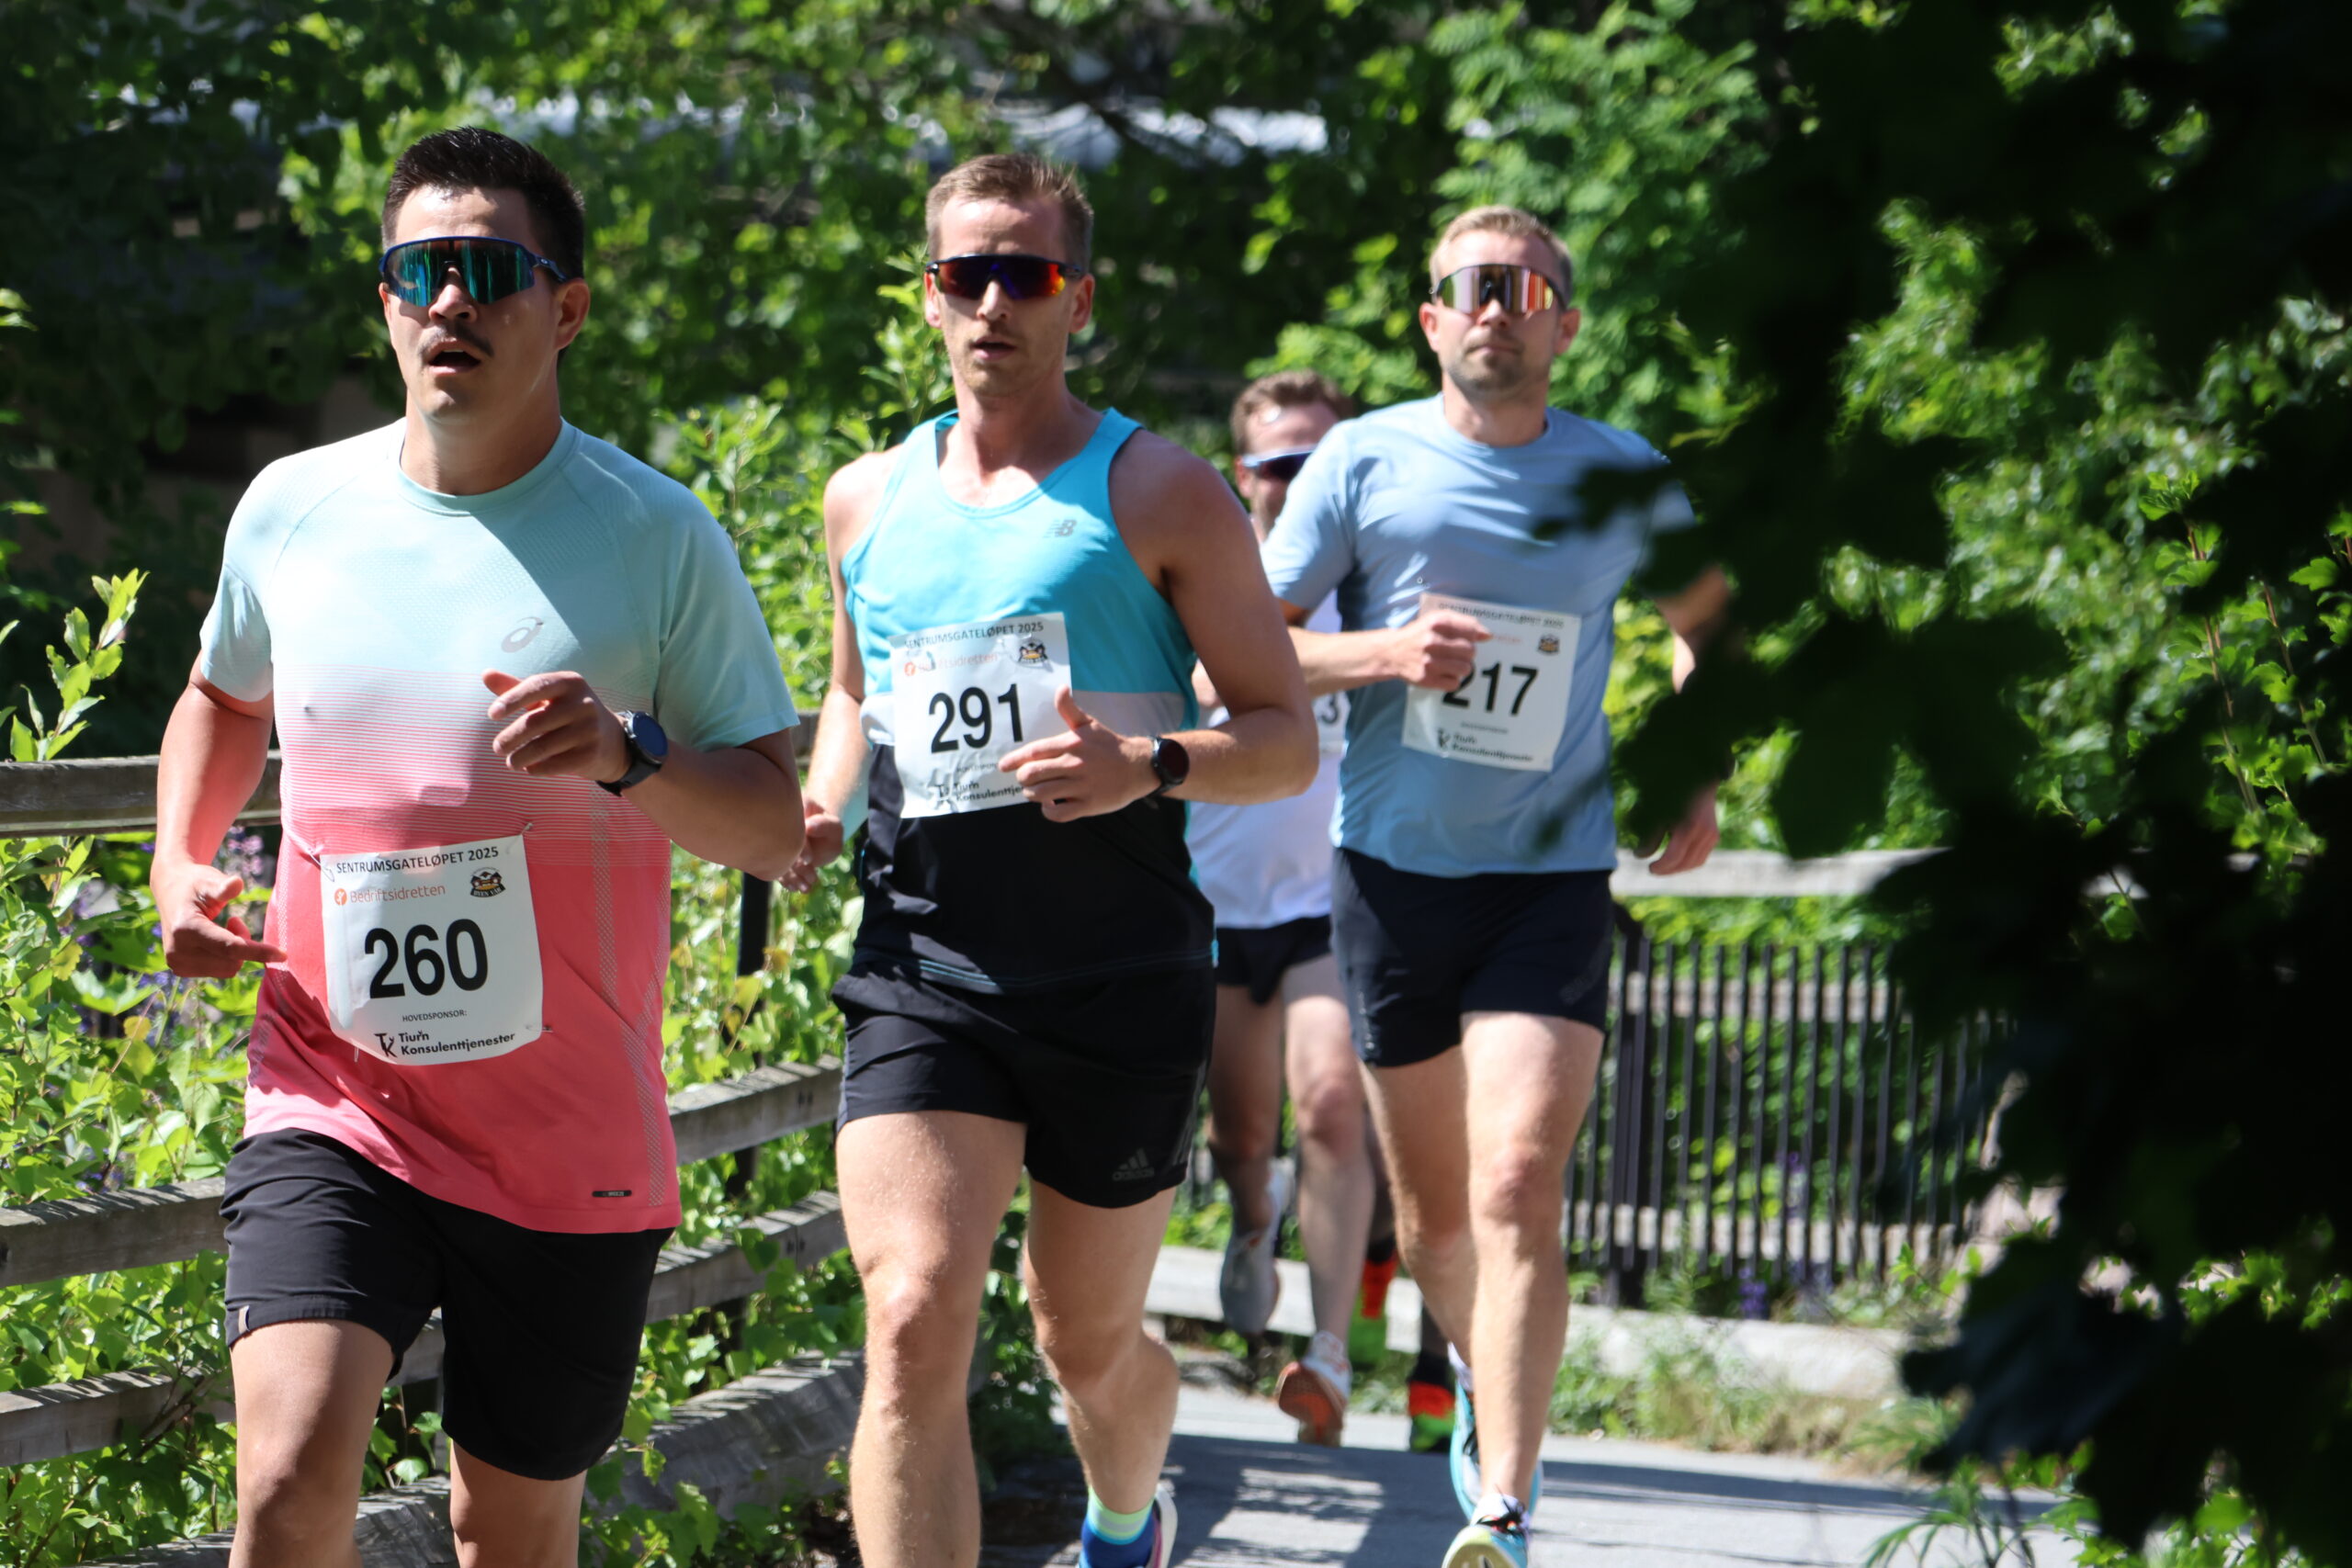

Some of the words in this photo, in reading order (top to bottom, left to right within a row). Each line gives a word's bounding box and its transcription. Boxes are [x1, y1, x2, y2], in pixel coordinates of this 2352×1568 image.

[1018, 621, 1045, 634] 2025
[929, 683, 1023, 753] 291
[336, 851, 464, 874] SENTRUMSGATELØPET
[468, 846, 499, 862] 2025
[350, 885, 446, 903] Bedriftsidretten
[365, 919, 489, 999] 260
[402, 1010, 467, 1022] HOVEDSPONSOR:
[401, 1032, 515, 1055] Konsulenttjenester
